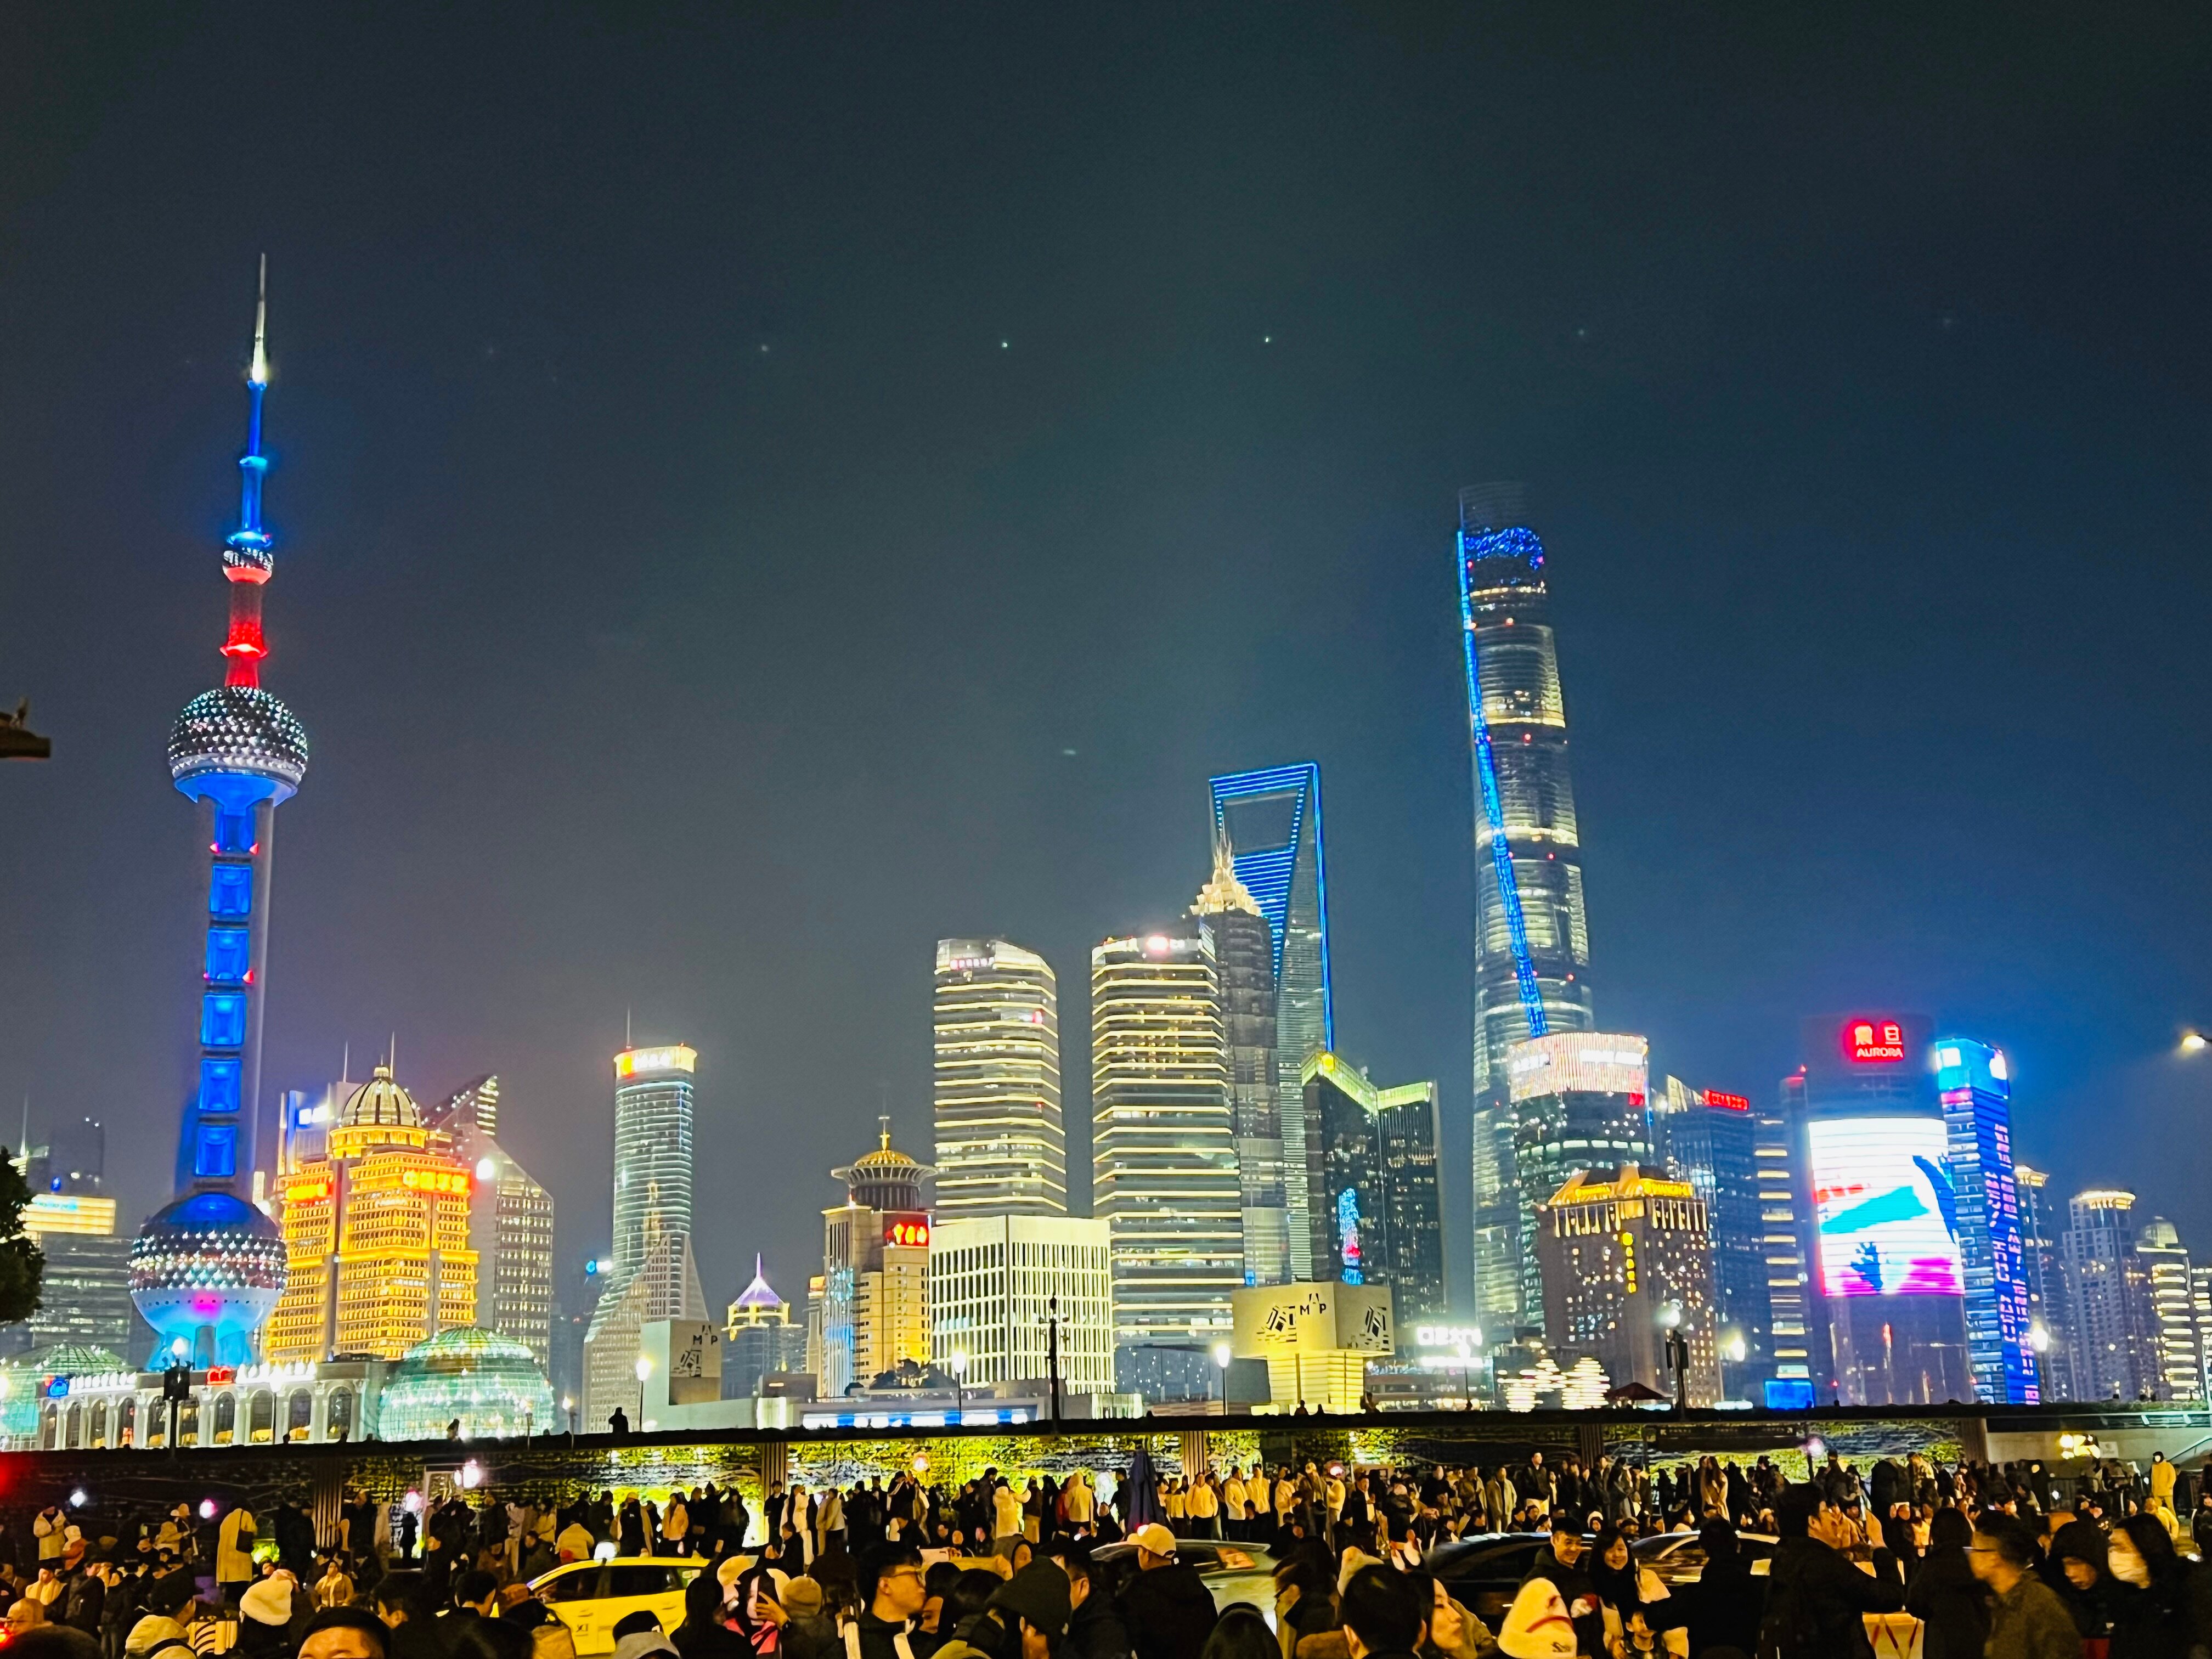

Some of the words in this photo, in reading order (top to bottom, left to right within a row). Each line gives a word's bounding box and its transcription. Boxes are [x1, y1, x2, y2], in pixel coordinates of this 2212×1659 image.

[1857, 1047, 1903, 1058] AURORA
[1299, 1293, 1327, 1316] MAP
[693, 1325, 718, 1345] MAP
